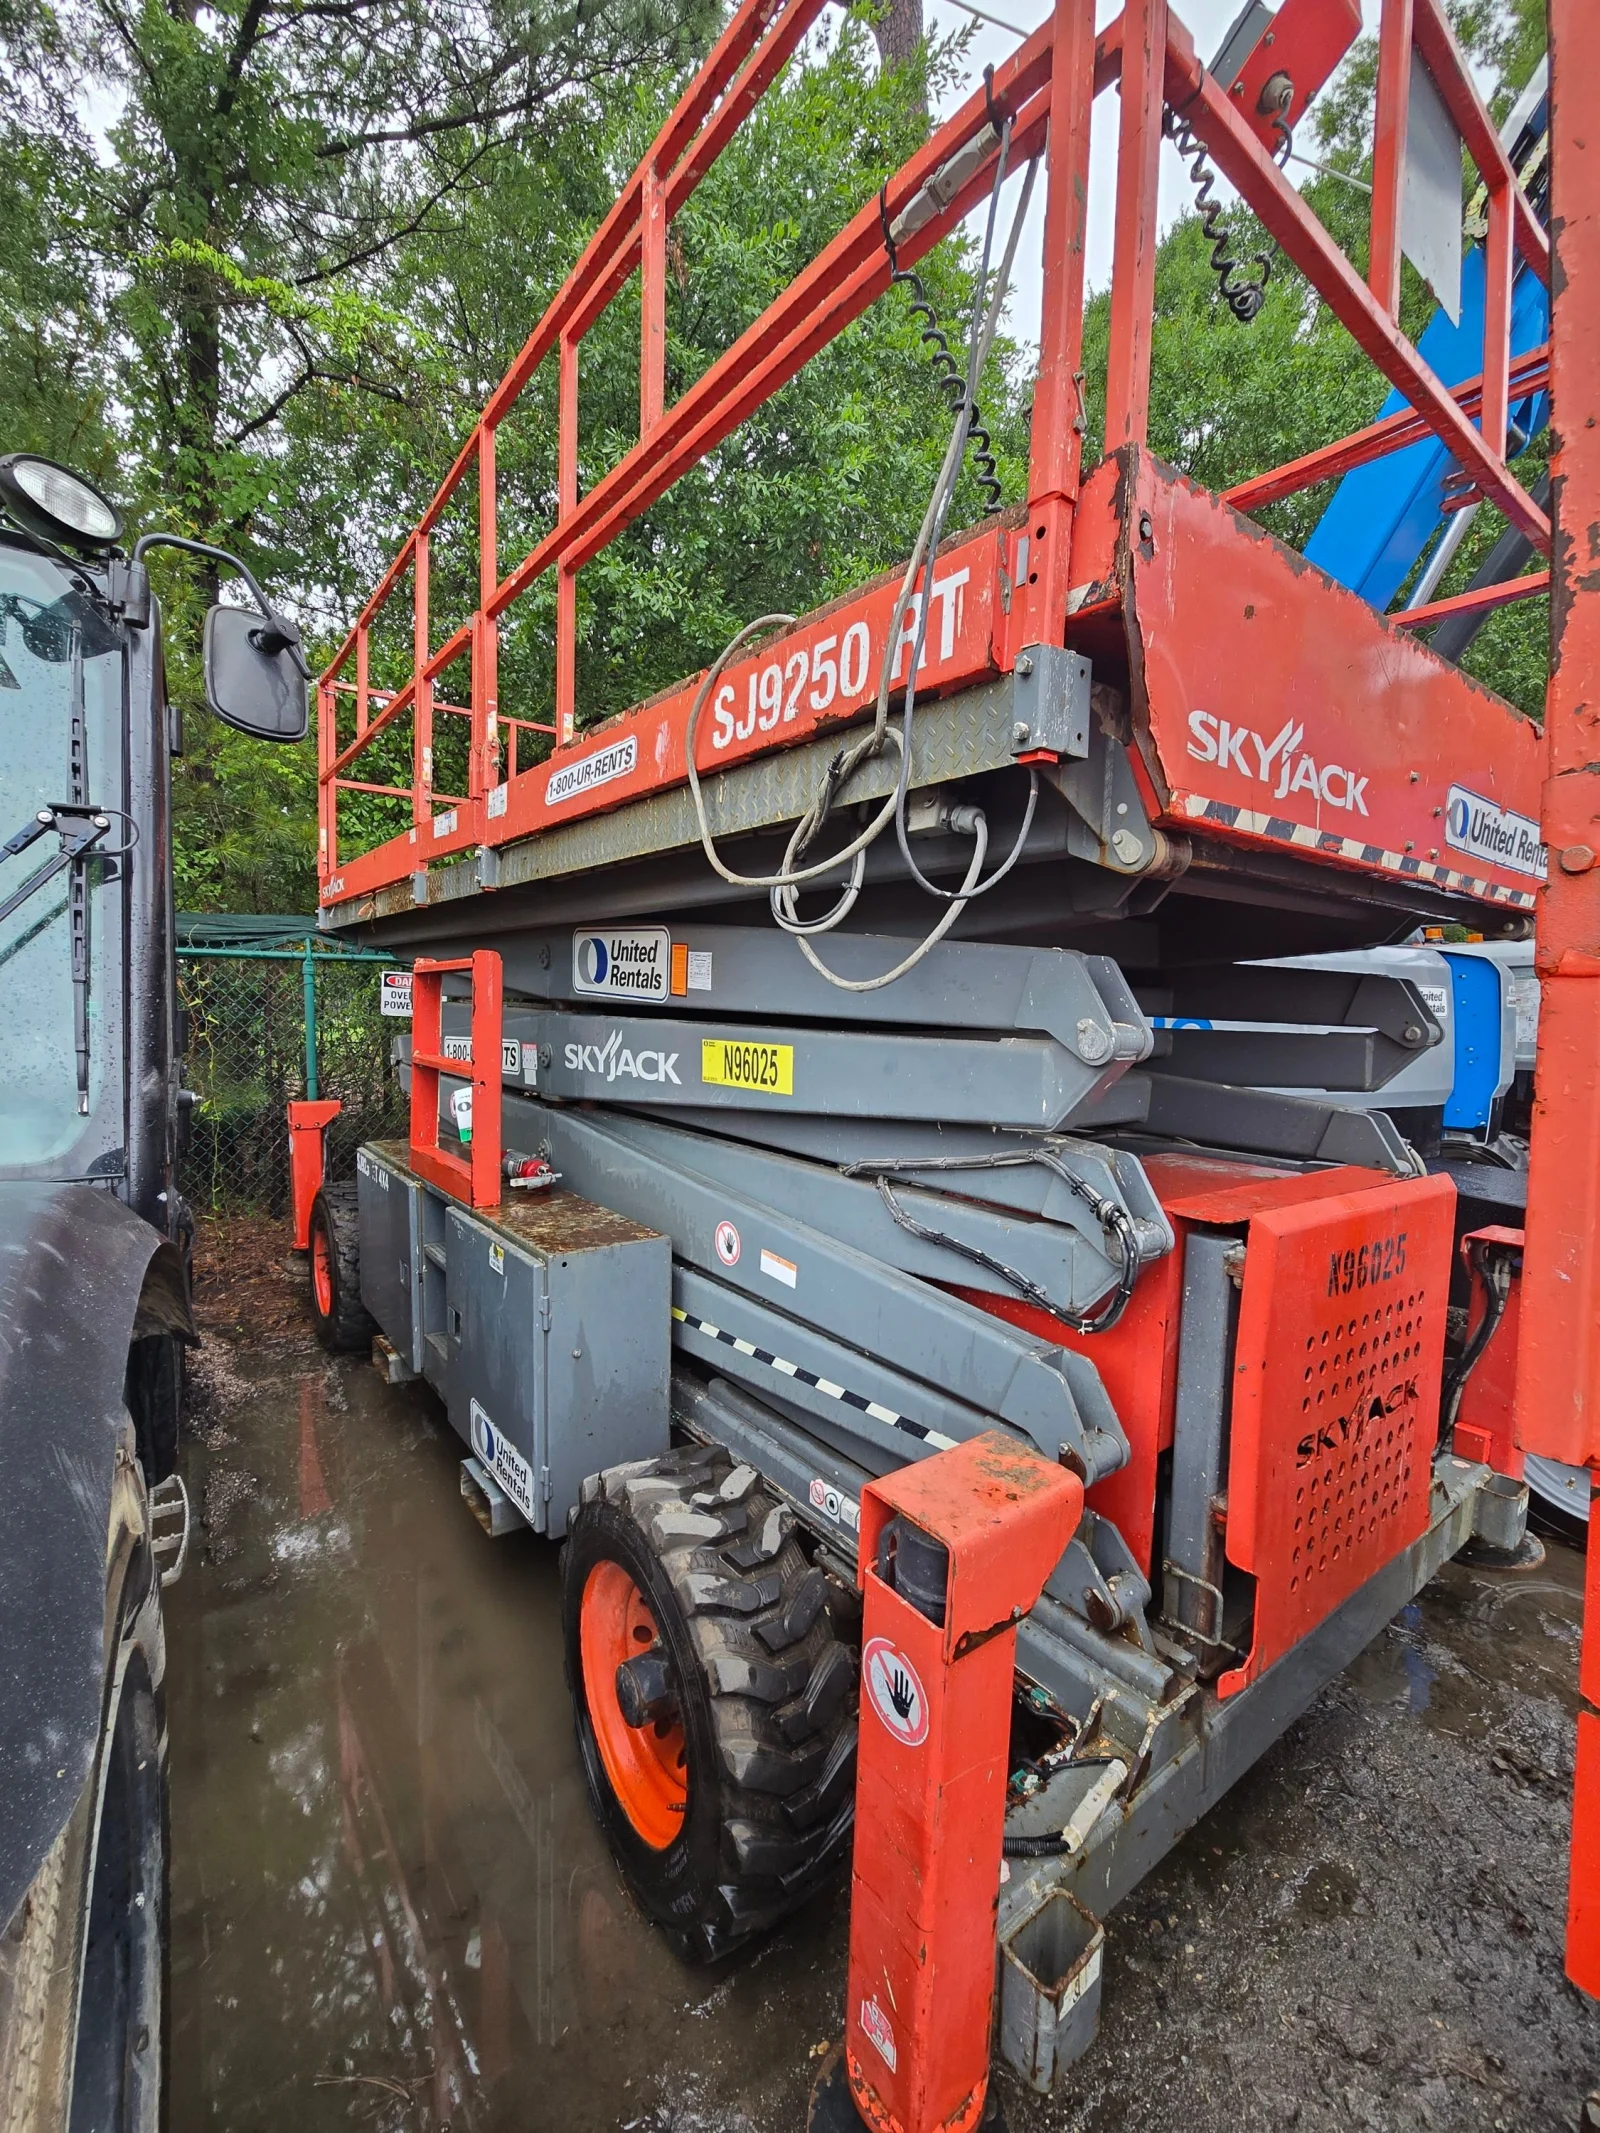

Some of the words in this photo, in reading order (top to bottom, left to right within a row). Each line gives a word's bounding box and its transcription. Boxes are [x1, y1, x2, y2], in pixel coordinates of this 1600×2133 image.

[712, 621, 870, 750] SJ9250
[890, 566, 970, 681] RT
[549, 743, 633, 798] 1-800-UR-RENTS
[1187, 709, 1370, 818] SKYJACK
[1471, 808, 1518, 857] United
[609, 964, 663, 990] Rentals
[610, 939, 659, 964] United
[384, 1000, 414, 1011] POWE
[564, 1029, 683, 1085] SKYJACK
[723, 1044, 779, 1087] N96025
[1327, 1232, 1409, 1298] N96025
[1296, 1372, 1421, 1471] SKYJACK
[496, 1436, 527, 1486] United
[496, 1455, 531, 1511] Rentals
